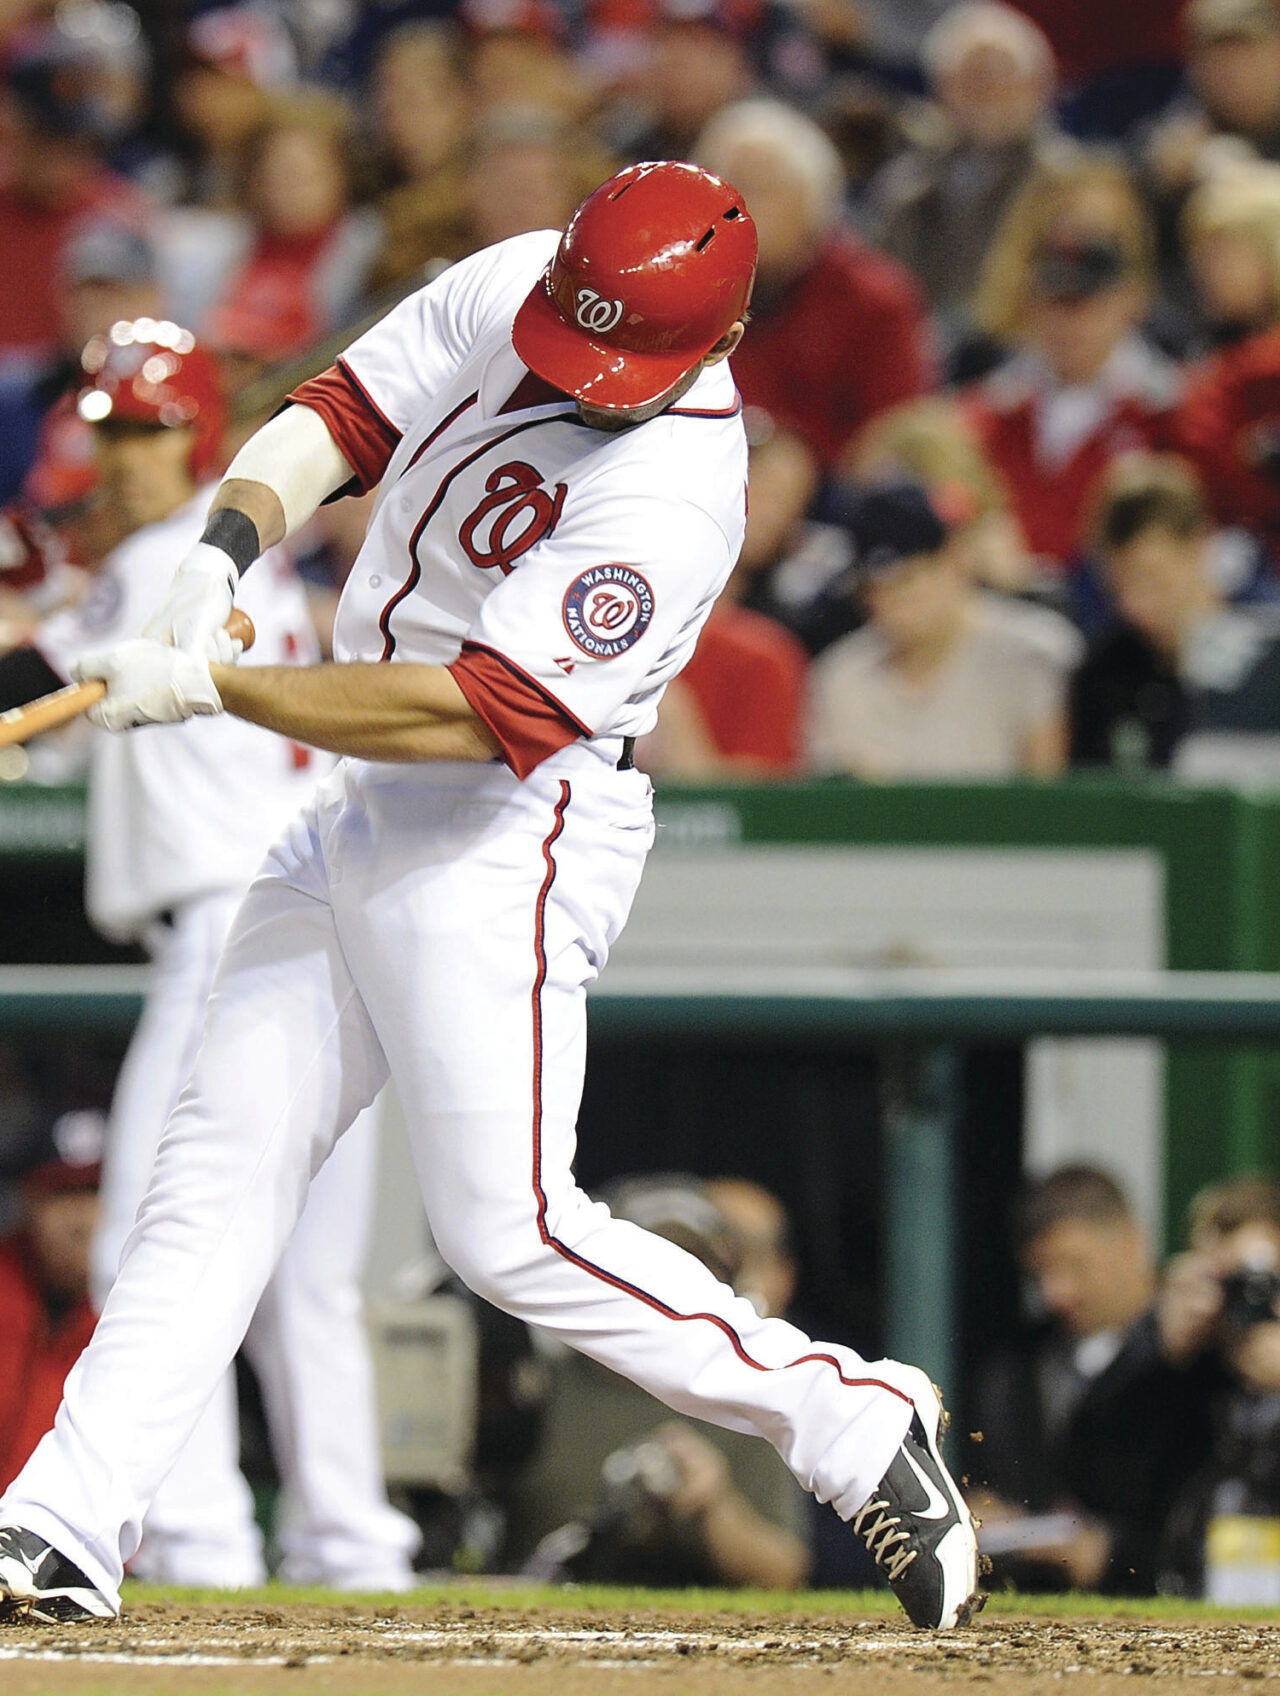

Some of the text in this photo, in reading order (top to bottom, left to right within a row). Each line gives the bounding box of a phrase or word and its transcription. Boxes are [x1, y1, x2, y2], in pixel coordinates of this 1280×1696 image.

[577, 289, 623, 333] W
[580, 567, 652, 623] WASHINGTON
[589, 592, 635, 630] W
[566, 607, 629, 656] NATIONALS
